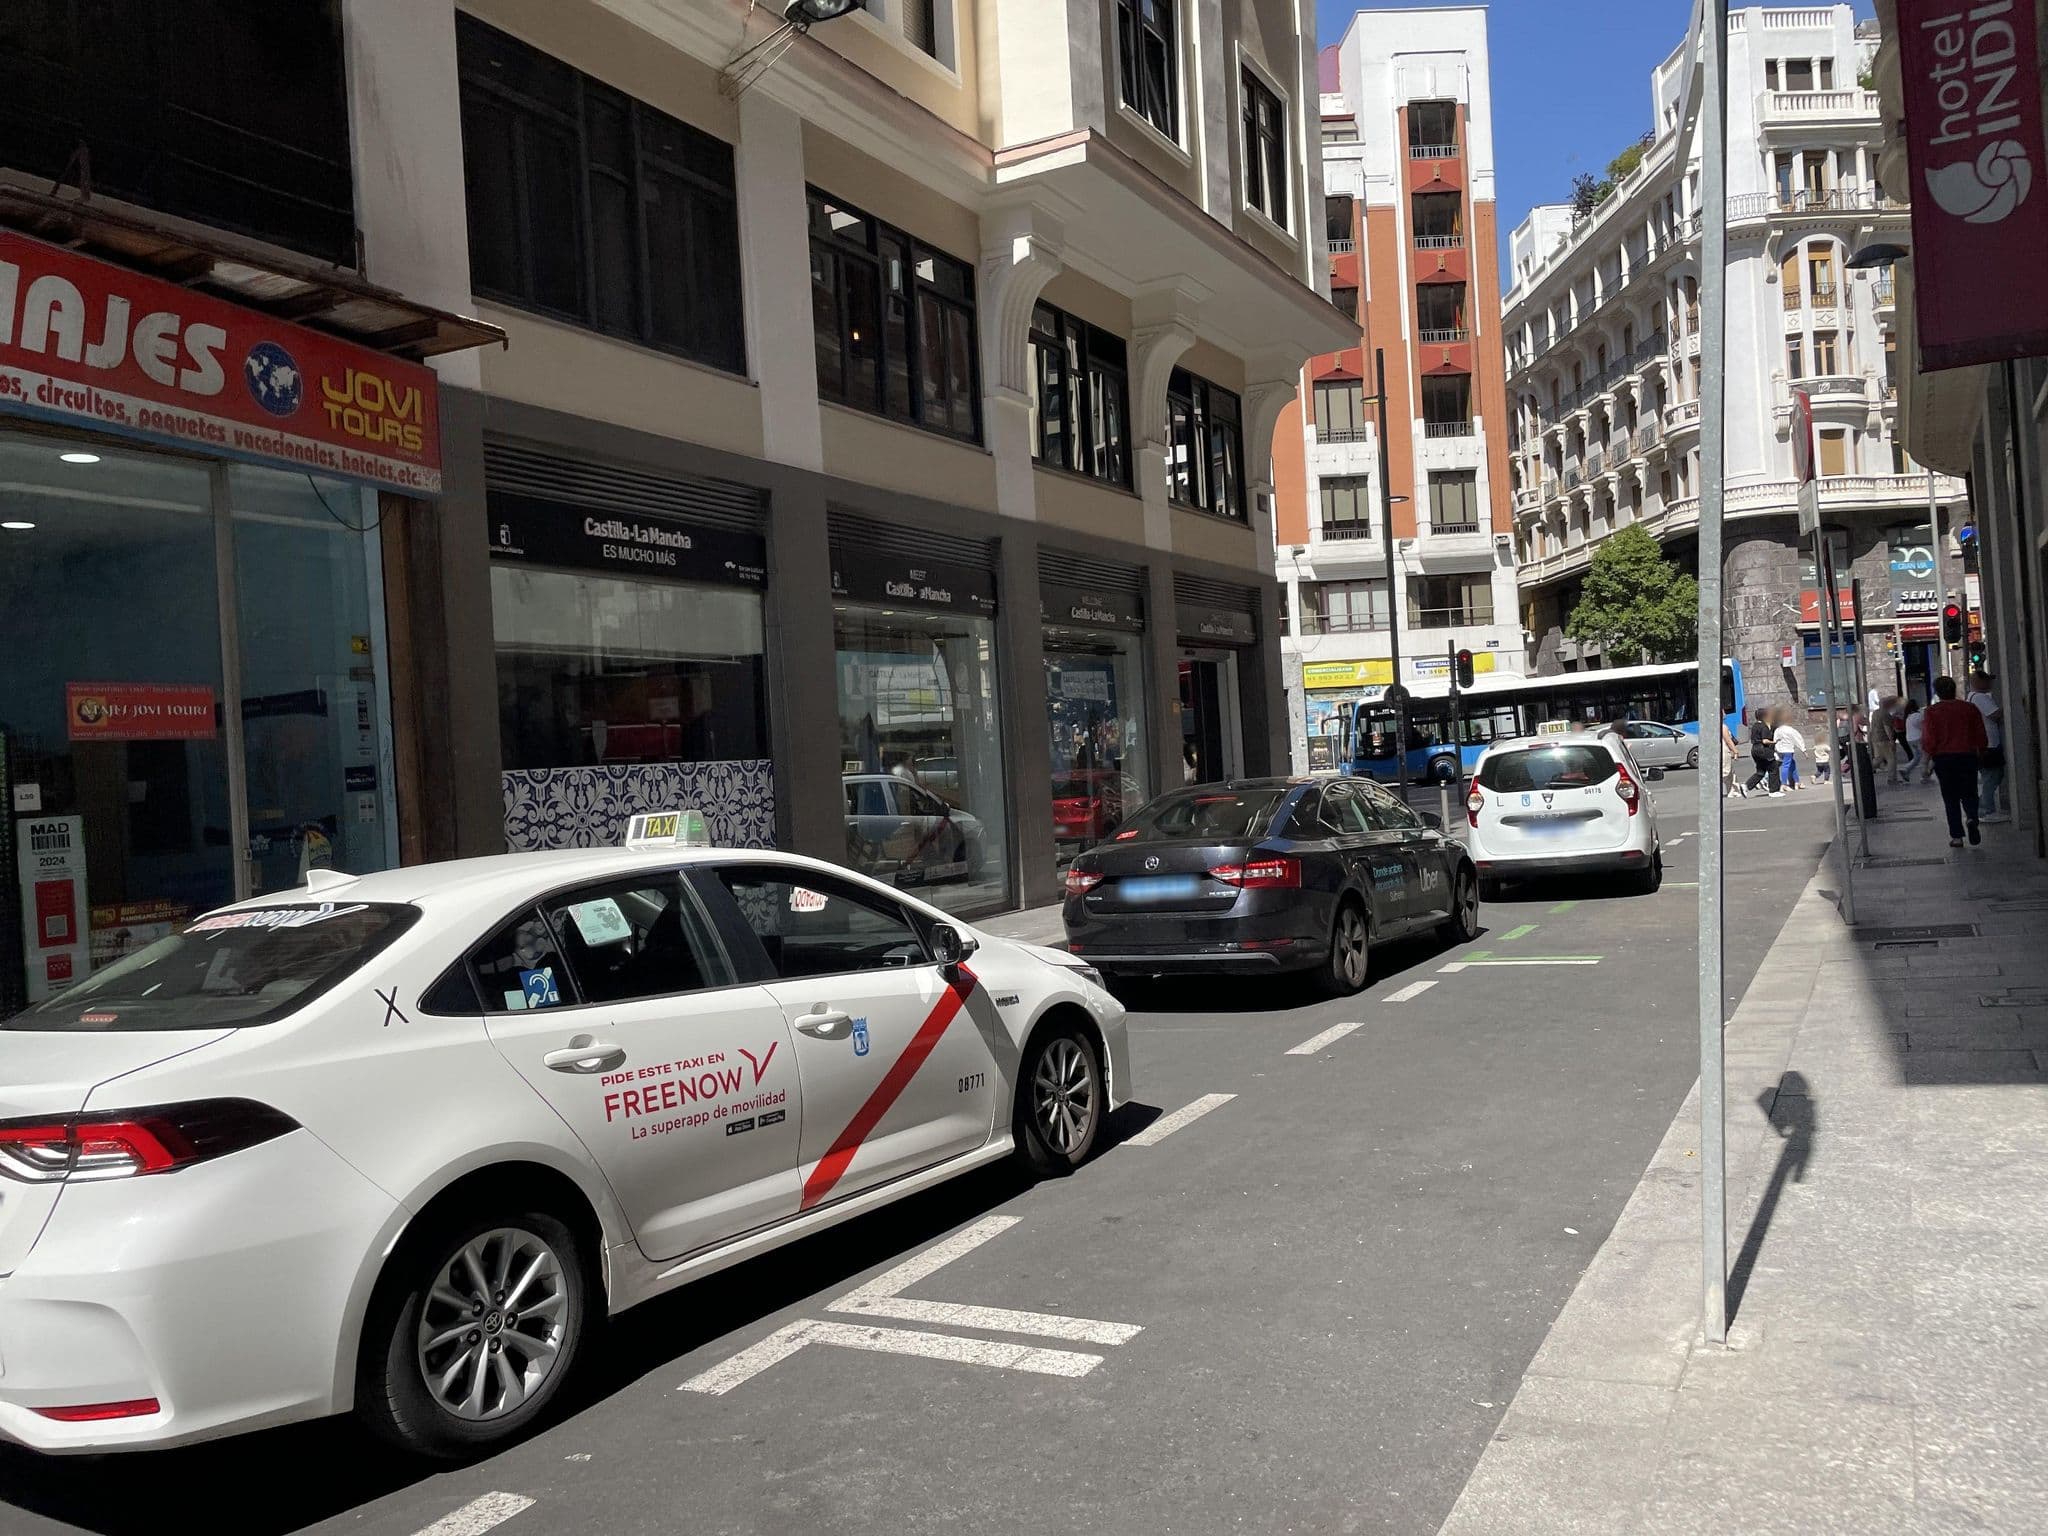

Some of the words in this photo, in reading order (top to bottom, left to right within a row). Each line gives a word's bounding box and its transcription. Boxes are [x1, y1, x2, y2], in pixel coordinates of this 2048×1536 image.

[1920, 13, 1972, 145] hotel
[321, 367, 423, 425] JOVI
[36, 377, 131, 424] circuitos,
[138, 408, 226, 442] paquetes
[321, 401, 423, 451] TOURS
[603, 544, 617, 559] ES
[618, 546, 653, 564] MUCHO
[655, 549, 677, 566] MÁS
[1901, 589, 1938, 601] SENT
[132, 703, 161, 719] JOVI
[166, 703, 208, 718] TOURS
[1548, 723, 1565, 734] TAXI
[1496, 796, 1504, 807] L
[30, 823, 69, 835] MAD
[647, 816, 677, 838] TAXI
[39, 856, 65, 867] 2024
[1418, 866, 1439, 892] Uber
[373, 985, 409, 1027] X
[601, 1071, 635, 1087] PIDE
[638, 1063, 672, 1079] ESTE
[674, 1056, 705, 1071] TAXI
[708, 1052, 726, 1064] EN
[604, 1066, 743, 1123] FREENOW
[958, 1072, 985, 1093] 08771
[631, 1126, 647, 1140] La
[651, 1109, 710, 1135] superapp
[713, 1104, 728, 1119] de
[731, 1088, 786, 1115] movilidad
